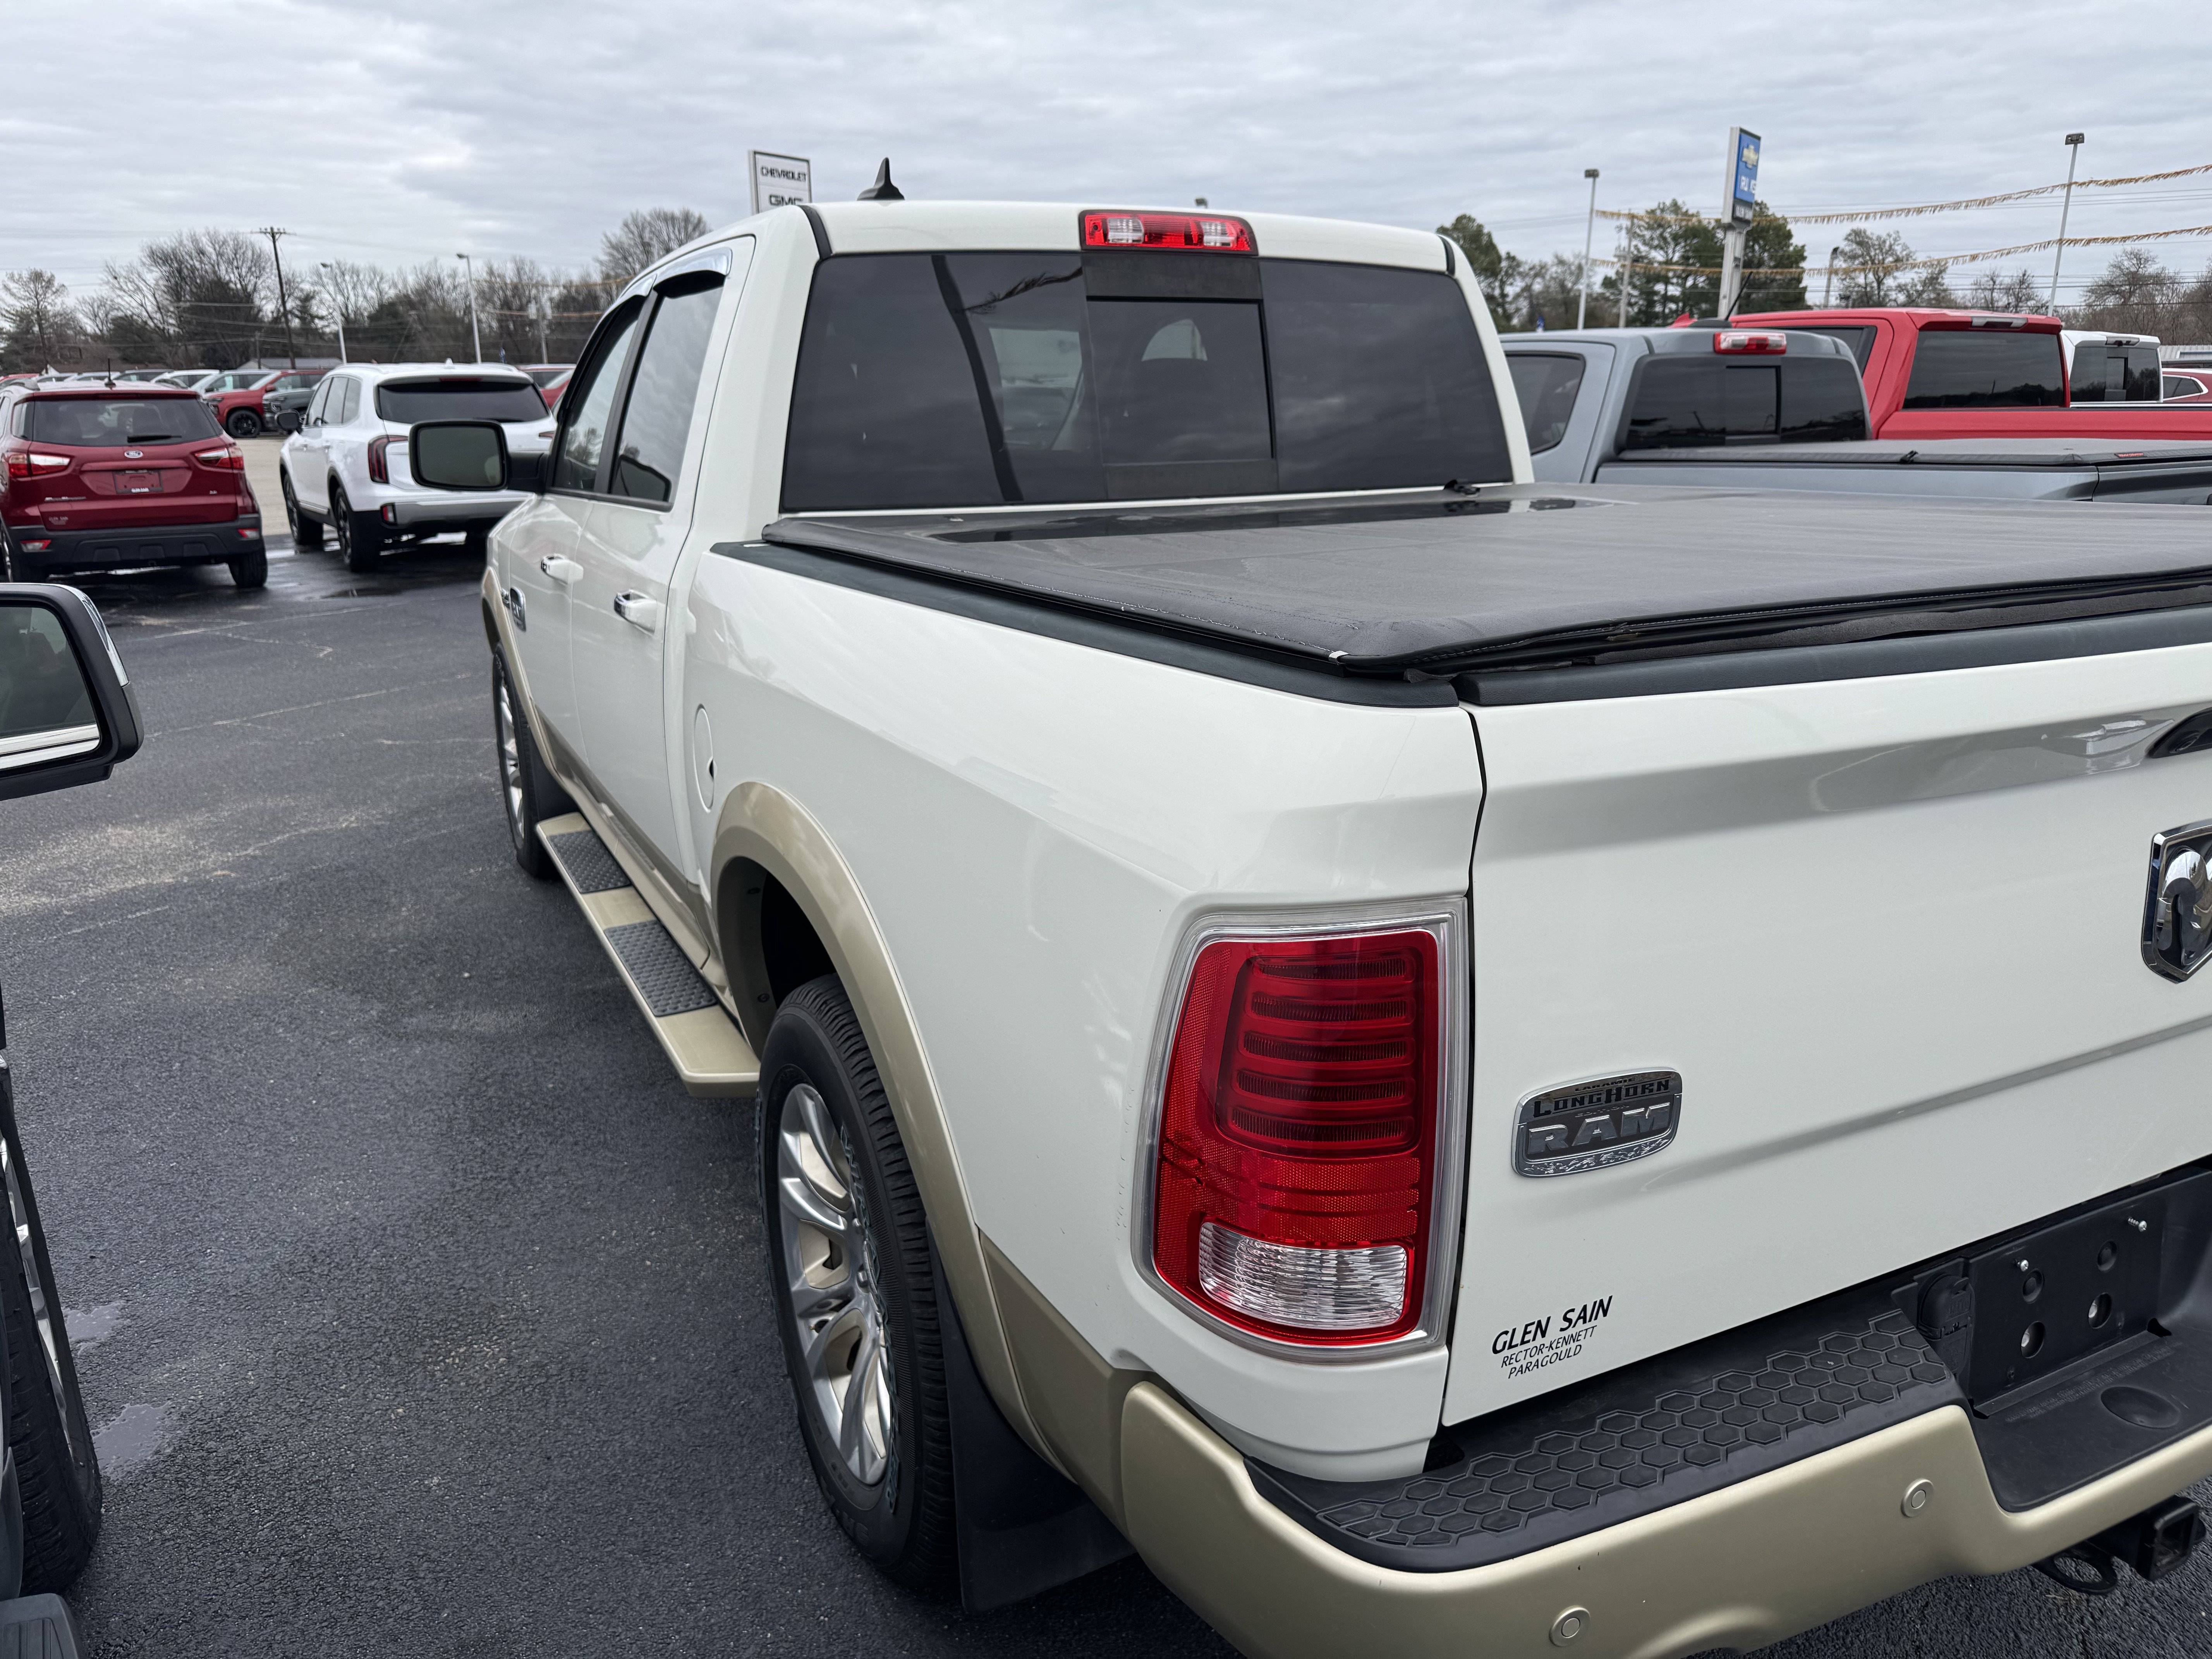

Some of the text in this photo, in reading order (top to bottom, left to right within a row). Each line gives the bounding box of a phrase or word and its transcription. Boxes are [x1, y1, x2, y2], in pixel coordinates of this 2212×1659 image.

[761, 166, 806, 182] CHEVROLET
[1533, 1079, 1670, 1118] LONGHORN
[1527, 1102, 1671, 1155] RAM
[1492, 1295, 1613, 1355] GLEN SAIN
[1501, 1325, 1597, 1368] RECTOR-KENNETT
[1508, 1344, 1582, 1379] PARAGOULD
